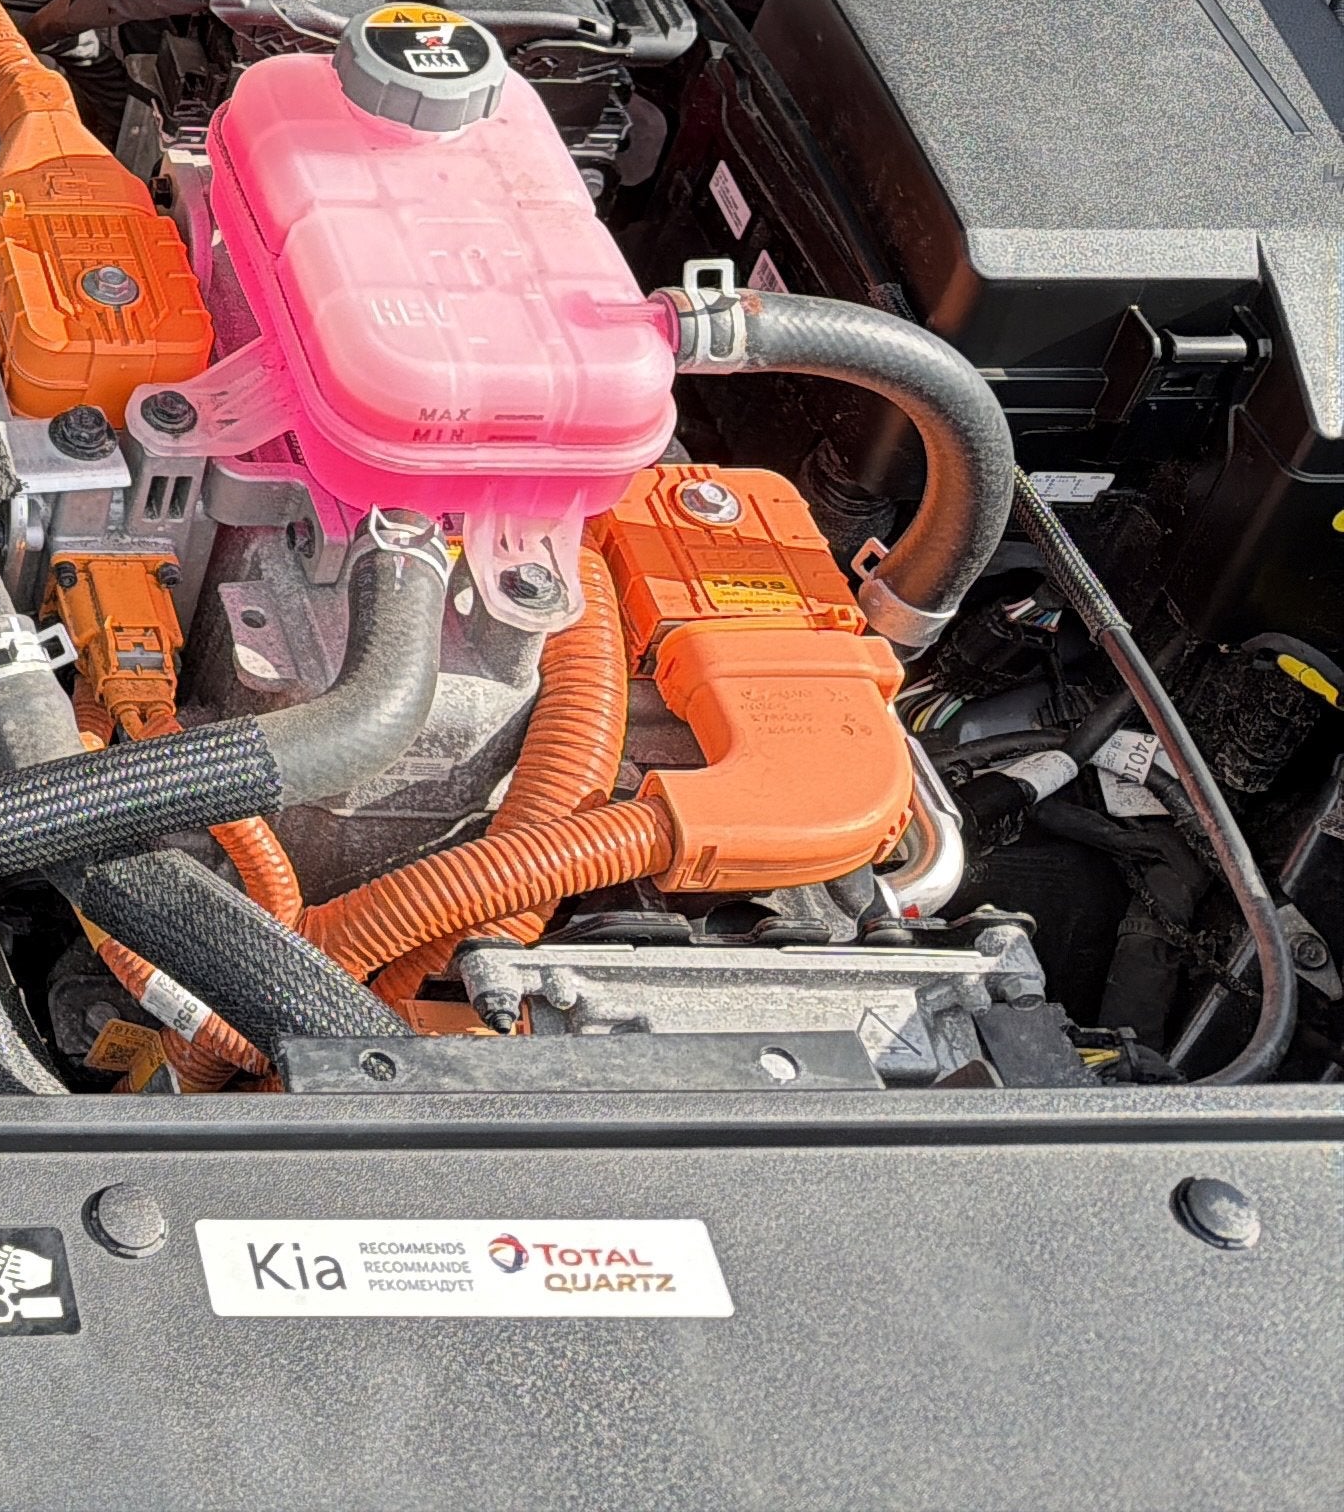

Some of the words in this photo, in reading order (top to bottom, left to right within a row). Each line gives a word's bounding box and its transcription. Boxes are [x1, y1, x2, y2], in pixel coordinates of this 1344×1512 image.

[418, 408, 471, 421] MAX
[412, 429, 464, 441] MIN
[358, 1241, 466, 1256] RECOMMENDS
[533, 1243, 653, 1267] TOTAL
[246, 1240, 348, 1291] Kia
[363, 1260, 472, 1275] RECOMMANDE
[367, 1278, 475, 1293] РЕКОМЕНДУЕТ
[543, 1272, 677, 1294] QUARTZ
